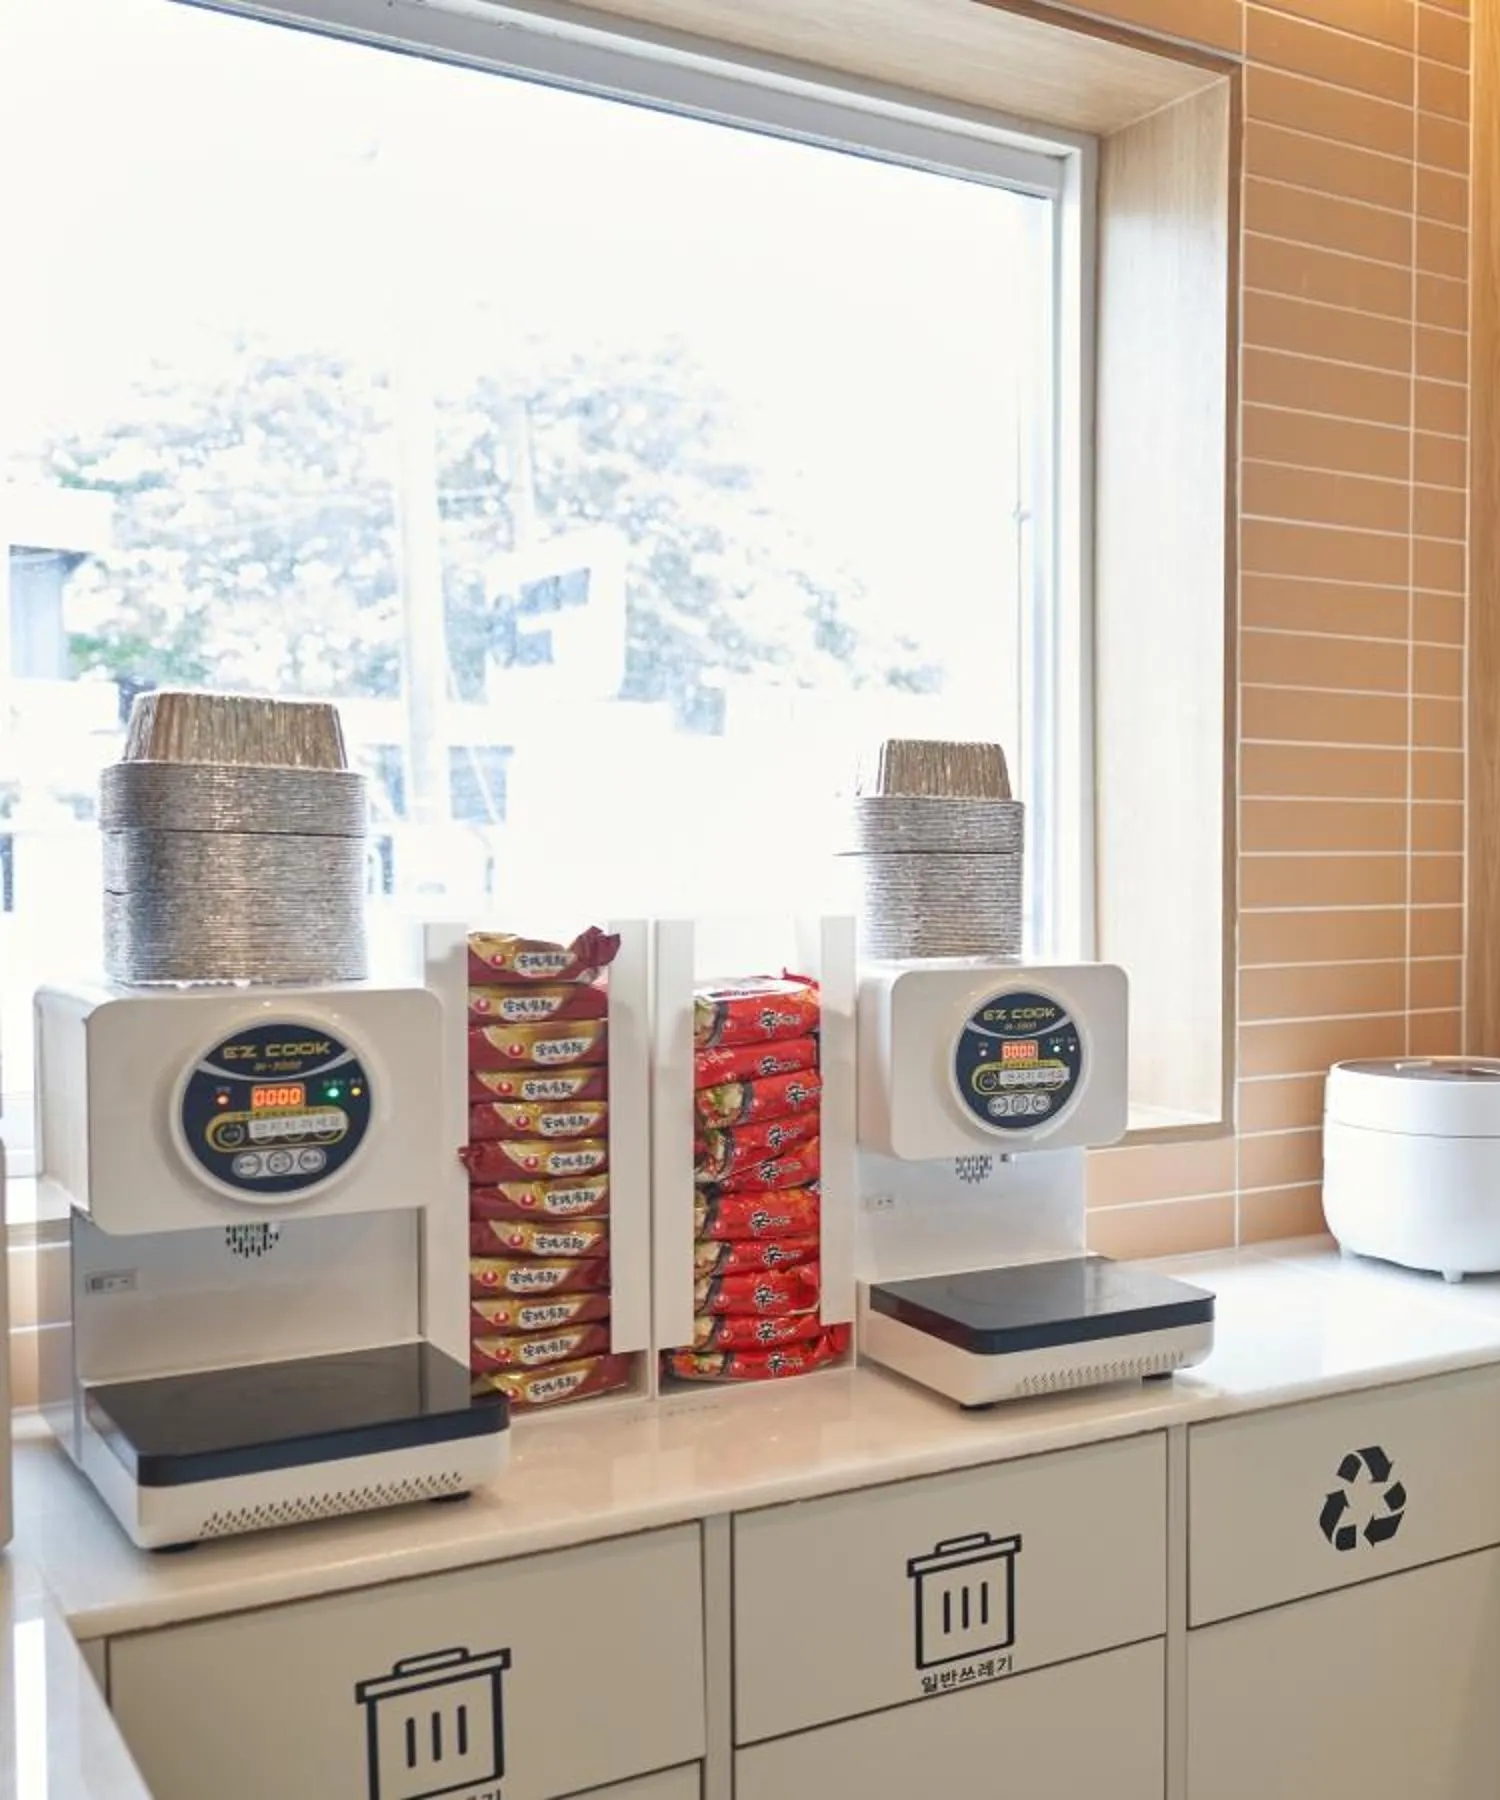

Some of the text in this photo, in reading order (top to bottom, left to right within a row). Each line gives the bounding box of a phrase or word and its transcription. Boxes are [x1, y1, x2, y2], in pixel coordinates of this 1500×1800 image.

[1011, 1006, 1056, 1020] COOK
[222, 1040, 332, 1060] EZ COOK
[254, 1086, 302, 1107] 0000
[921, 1654, 1013, 1693] 일반쓰레기
